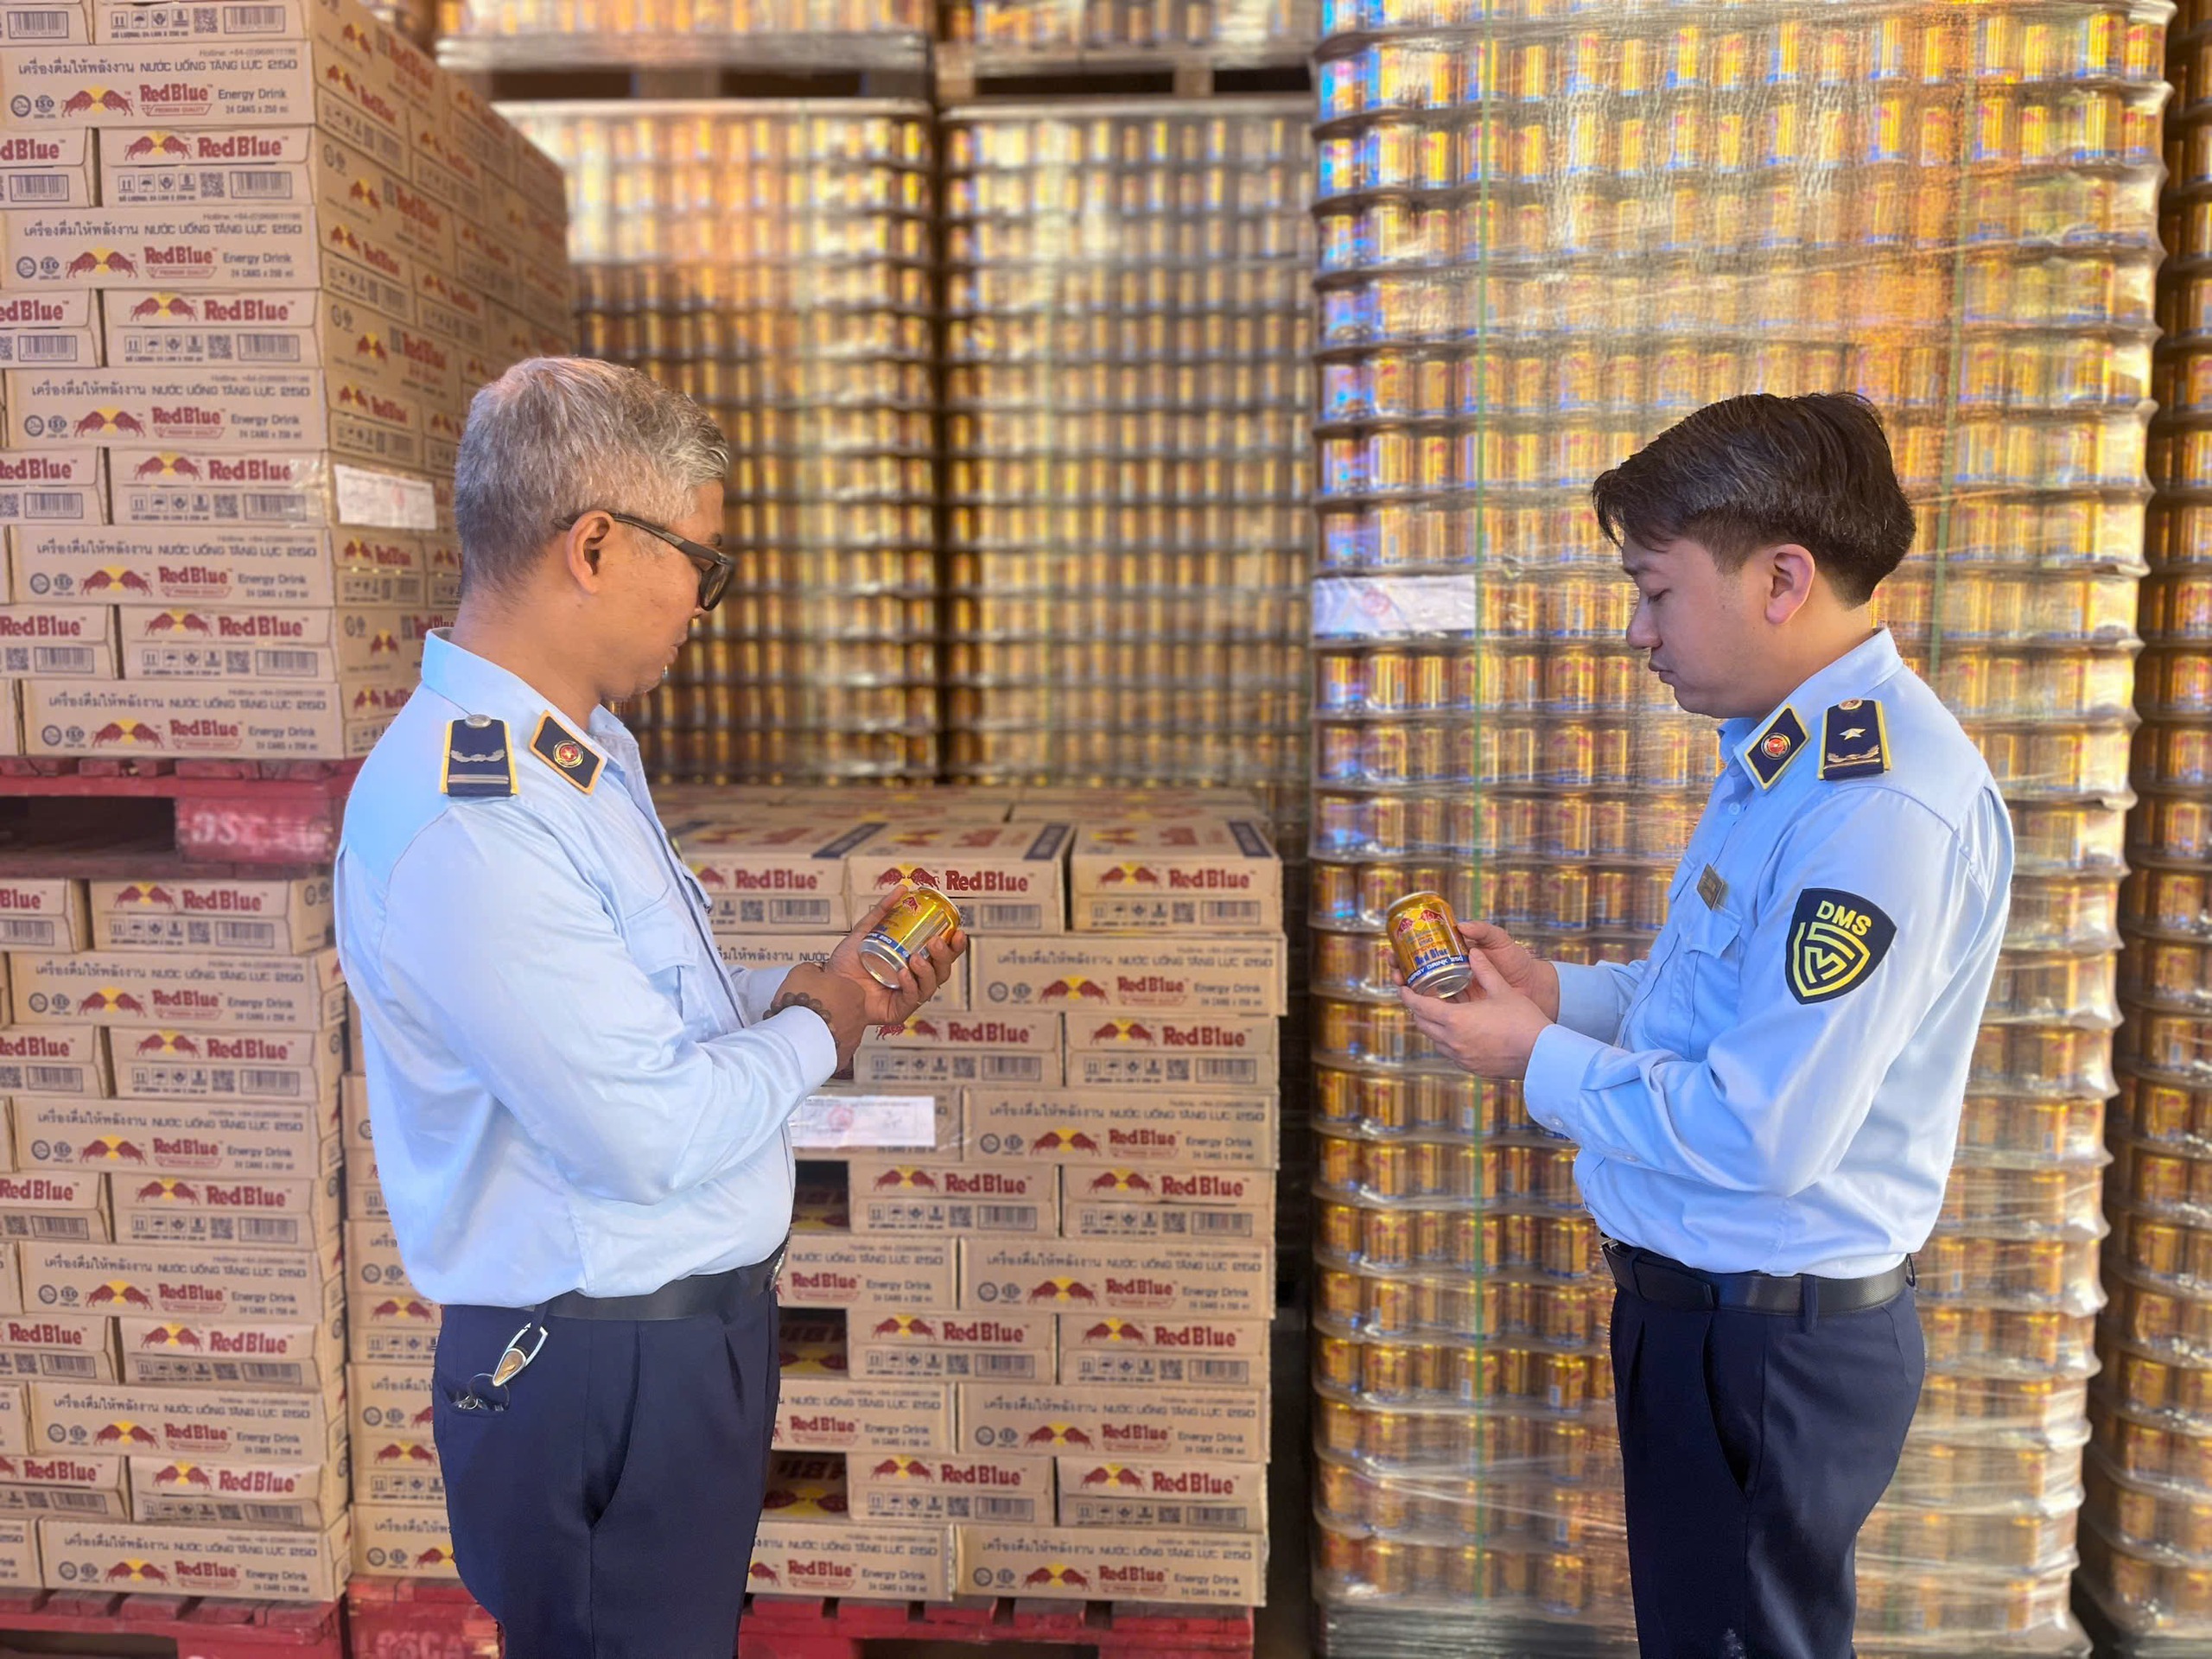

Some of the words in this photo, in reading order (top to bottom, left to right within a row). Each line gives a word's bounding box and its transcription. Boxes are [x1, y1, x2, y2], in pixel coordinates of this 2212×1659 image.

[268, 60, 297, 70] 250
[140, 83, 208, 102] RedBlue
[218, 88, 254, 101] Energy
[258, 88, 287, 99] Drink
[35, 99, 54, 108] ISO
[0, 139, 60, 161] dBlue
[199, 136, 282, 158] RedBlue
[272, 225, 302, 234] 250
[144, 246, 213, 264] RedBlue
[223, 252, 259, 264] Energy
[264, 252, 292, 262] Drink
[41, 260, 60, 269] ISO
[0, 300, 64, 323] edBlue
[204, 299, 289, 321] RedBlue
[152, 407, 221, 424] RedBlue
[231, 413, 268, 426] Energy
[271, 414, 301, 423] Drink
[159, 567, 228, 584] RedBlue
[238, 573, 274, 586] Energy
[278, 574, 307, 584] Drink
[219, 615, 302, 637] RedBlue
[170, 720, 238, 736] RedBlue
[248, 726, 284, 738] Energy
[288, 728, 316, 736] Drink
[736, 868, 817, 889] RedBlue
[945, 870, 1027, 892] RedBlue
[1170, 869, 1249, 889] RedBlue
[0, 887, 41, 909] Blue
[182, 888, 261, 912] RedBlue
[1816, 900, 1872, 937] DMS
[1427, 958, 1449, 969] DRINK
[1116, 976, 1185, 993] RedBlue
[152, 990, 219, 1007] RedBlue
[949, 1022, 1030, 1042] RedBlue
[1163, 1026, 1244, 1047] RedBlue
[207, 1039, 288, 1059] RedBlue
[153, 1138, 218, 1155] RedBlue
[1108, 1129, 1176, 1146] RedBlue
[945, 1173, 1026, 1194] RedBlue
[1161, 1176, 1243, 1197] RedBlue
[205, 1185, 285, 1207] RedBlue
[791, 1273, 857, 1288] RedBlue
[1105, 1279, 1173, 1295] RedBlue
[158, 1283, 223, 1300] RedBlue
[9, 1322, 83, 1344] RedBlue
[944, 1322, 1024, 1344] RedBlue
[1155, 1326, 1236, 1347] RedBlue
[210, 1332, 287, 1355] RedBlue
[164, 1423, 227, 1440] RedBlue
[790, 1416, 855, 1433] RedBlue
[1102, 1424, 1168, 1440] RedBlue
[23, 1459, 97, 1481] RedBlue
[941, 1462, 1020, 1485] RedBlue
[219, 1470, 296, 1494] RedBlue
[1153, 1471, 1233, 1494] RedBlue
[175, 1561, 237, 1578] RedBlue
[787, 1560, 853, 1577] RedBlue
[1098, 1566, 1165, 1582] RedBlue
